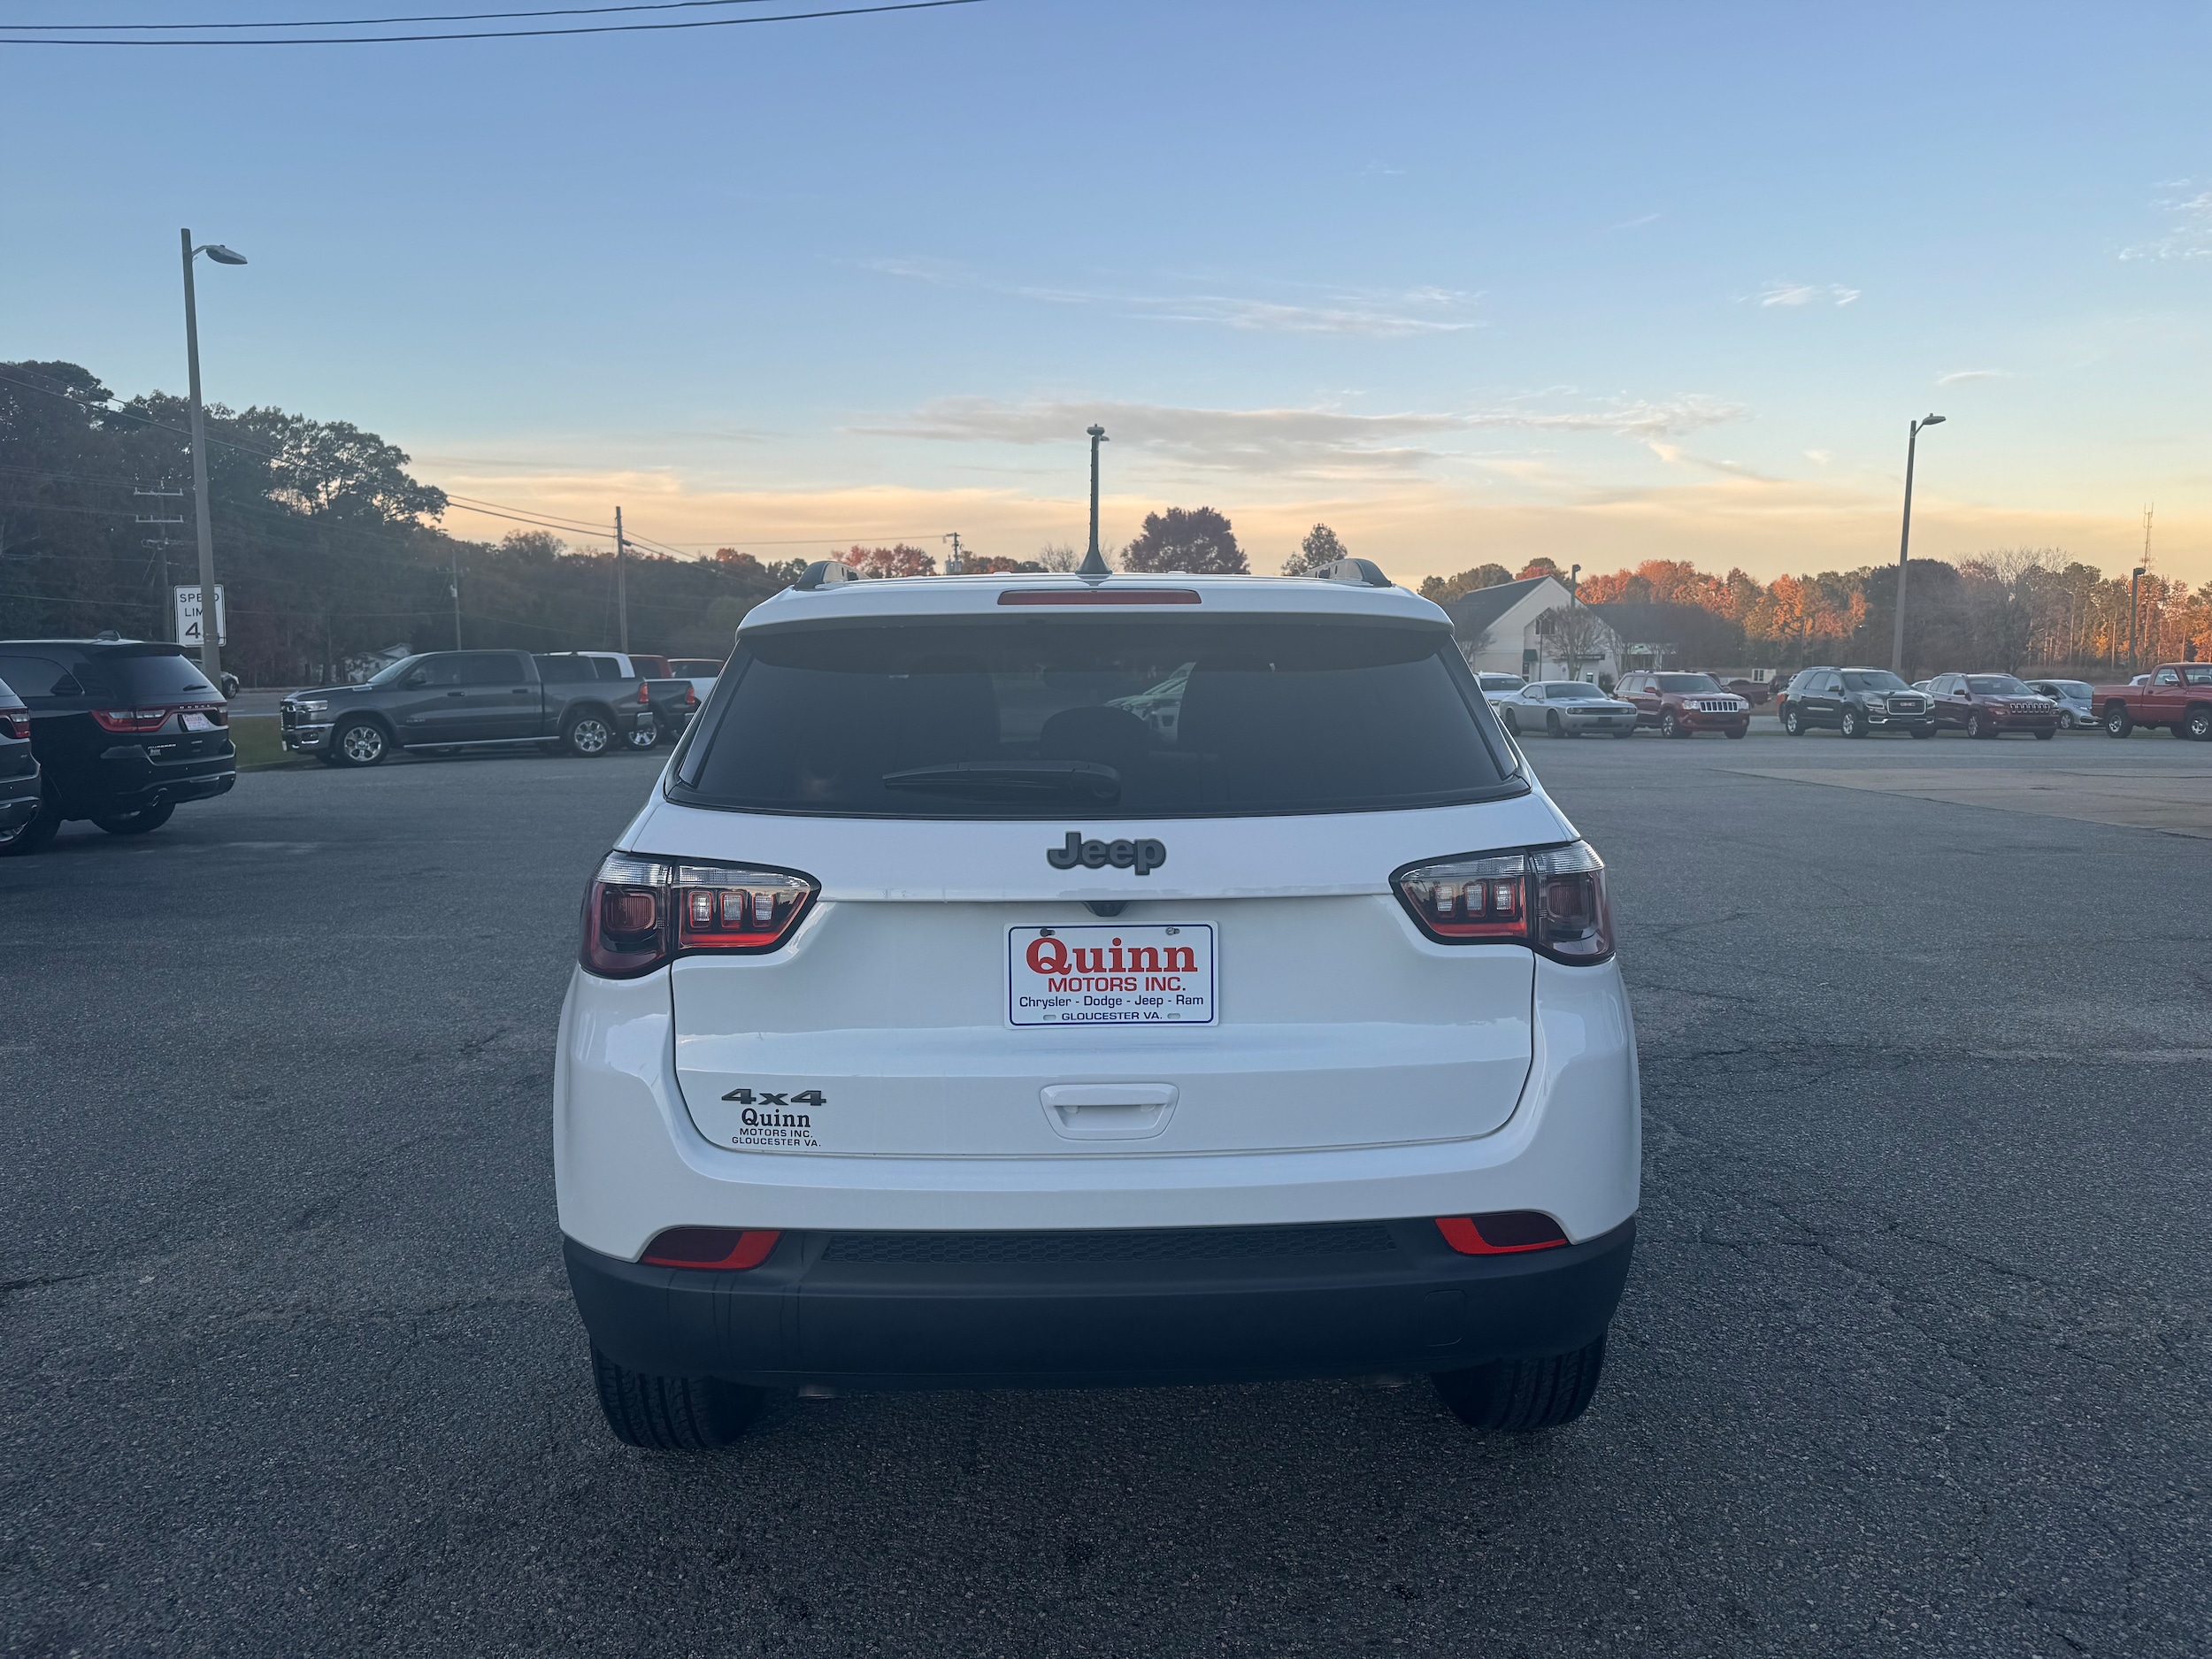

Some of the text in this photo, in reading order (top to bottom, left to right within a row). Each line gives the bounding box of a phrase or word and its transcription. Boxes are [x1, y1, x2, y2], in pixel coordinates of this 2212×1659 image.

[180, 593, 219, 603] SPED
[1046, 830, 1167, 876] Jeep
[1025, 937, 1198, 975] Quinn
[1048, 976, 1187, 993] MOTORS INC.
[1018, 996, 1071, 1010] Chrysler
[1083, 995, 1123, 1008] Dodge
[1134, 995, 1164, 1007] Jeep
[1176, 995, 1204, 1005] Ram
[1062, 1011, 1163, 1021] GLOUCESTER VA.
[721, 1088, 827, 1106] 4x4
[741, 1108, 811, 1127] Quinn
[740, 1128, 787, 1137] MOTORS
[732, 1137, 801, 1146] GLOUCESTER
